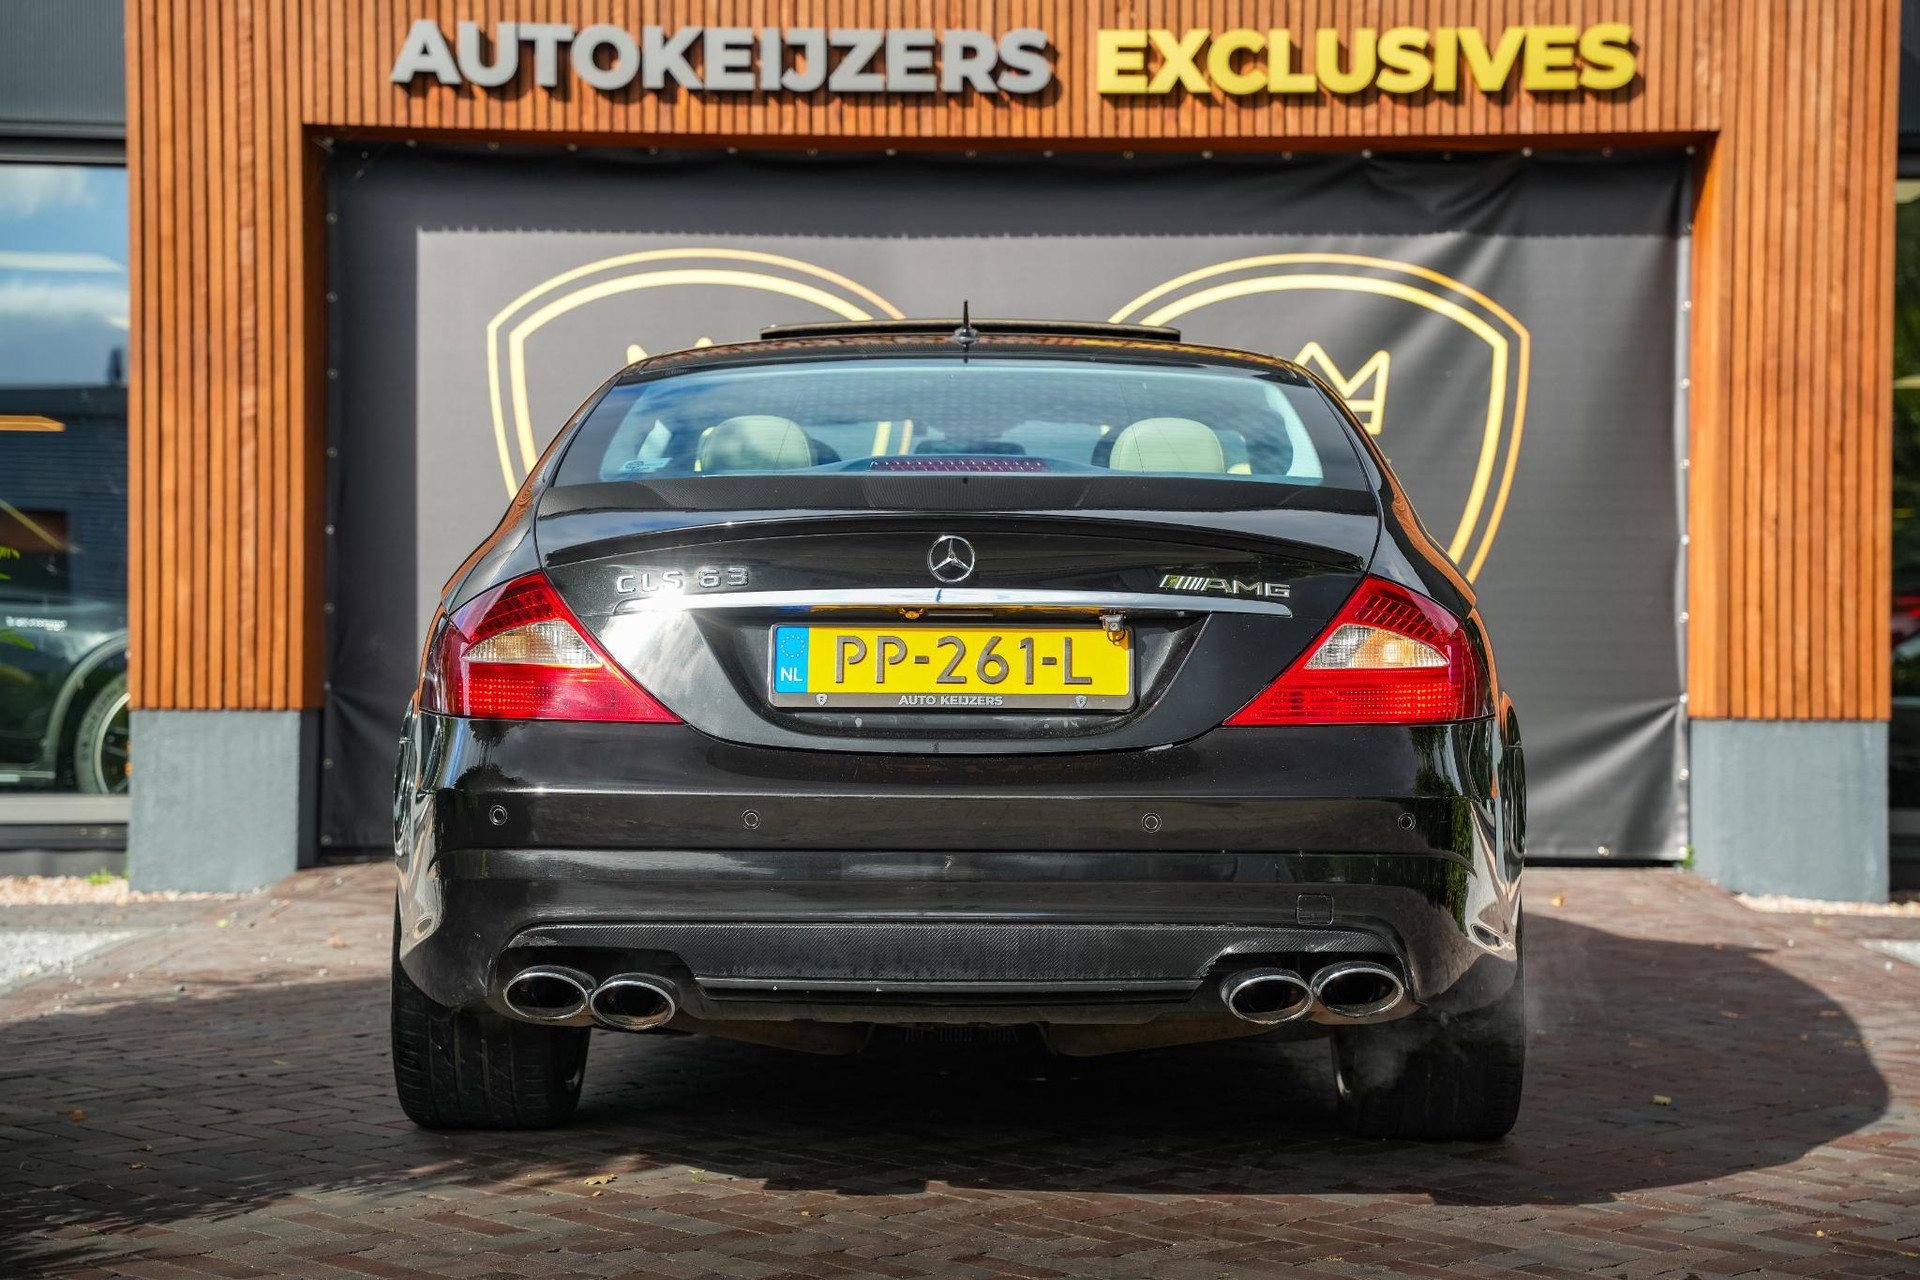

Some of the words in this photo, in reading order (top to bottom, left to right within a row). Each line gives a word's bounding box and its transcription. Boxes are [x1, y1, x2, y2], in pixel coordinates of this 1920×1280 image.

[390, 18, 1052, 95] AUTOKEIJZERS
[1097, 22, 1637, 95] EXCLUSIVES
[616, 570, 684, 594] CLS
[699, 567, 749, 588] 63
[1200, 577, 1291, 598] AMG
[834, 634, 1093, 685] PP-261-L
[780, 667, 803, 682] NL
[898, 695, 936, 706] AUTO
[940, 695, 1003, 706] KEIJZERS
